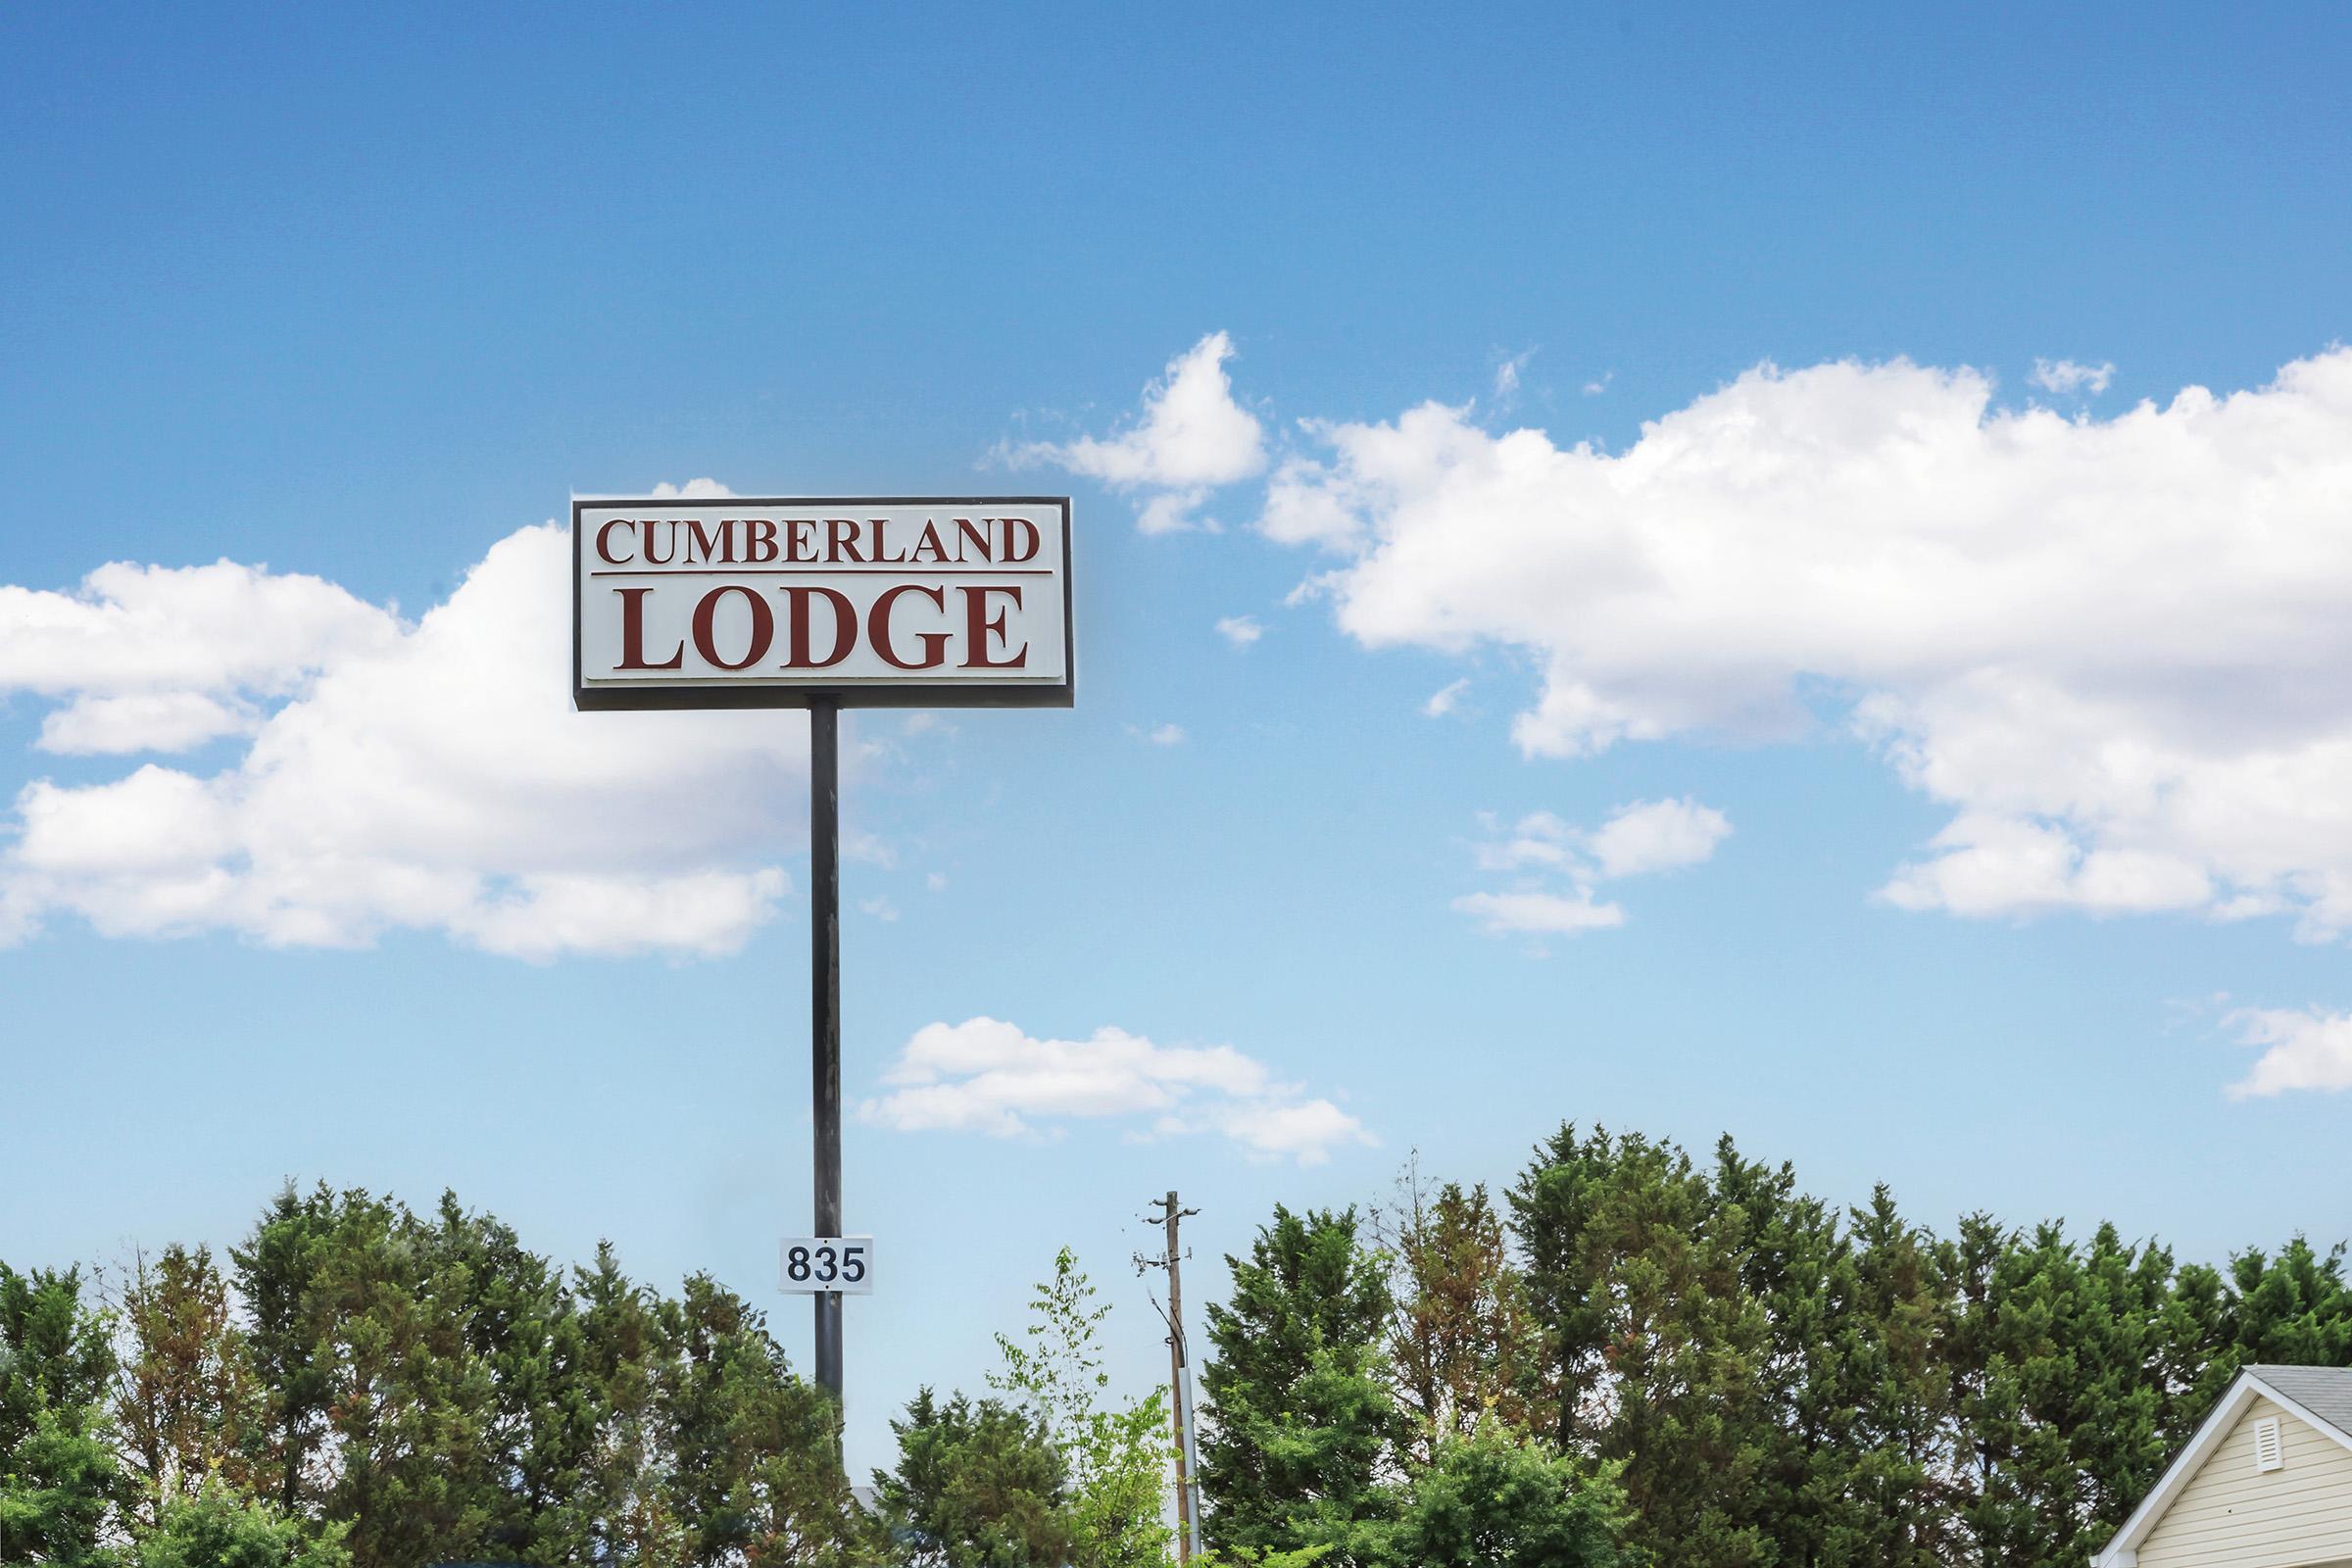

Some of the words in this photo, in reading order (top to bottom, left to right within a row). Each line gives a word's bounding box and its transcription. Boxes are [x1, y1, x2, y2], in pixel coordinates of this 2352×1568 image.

[596, 518, 1040, 564] CUMBERLAND
[612, 584, 1028, 670] LODGE
[788, 1247, 865, 1282] 835
